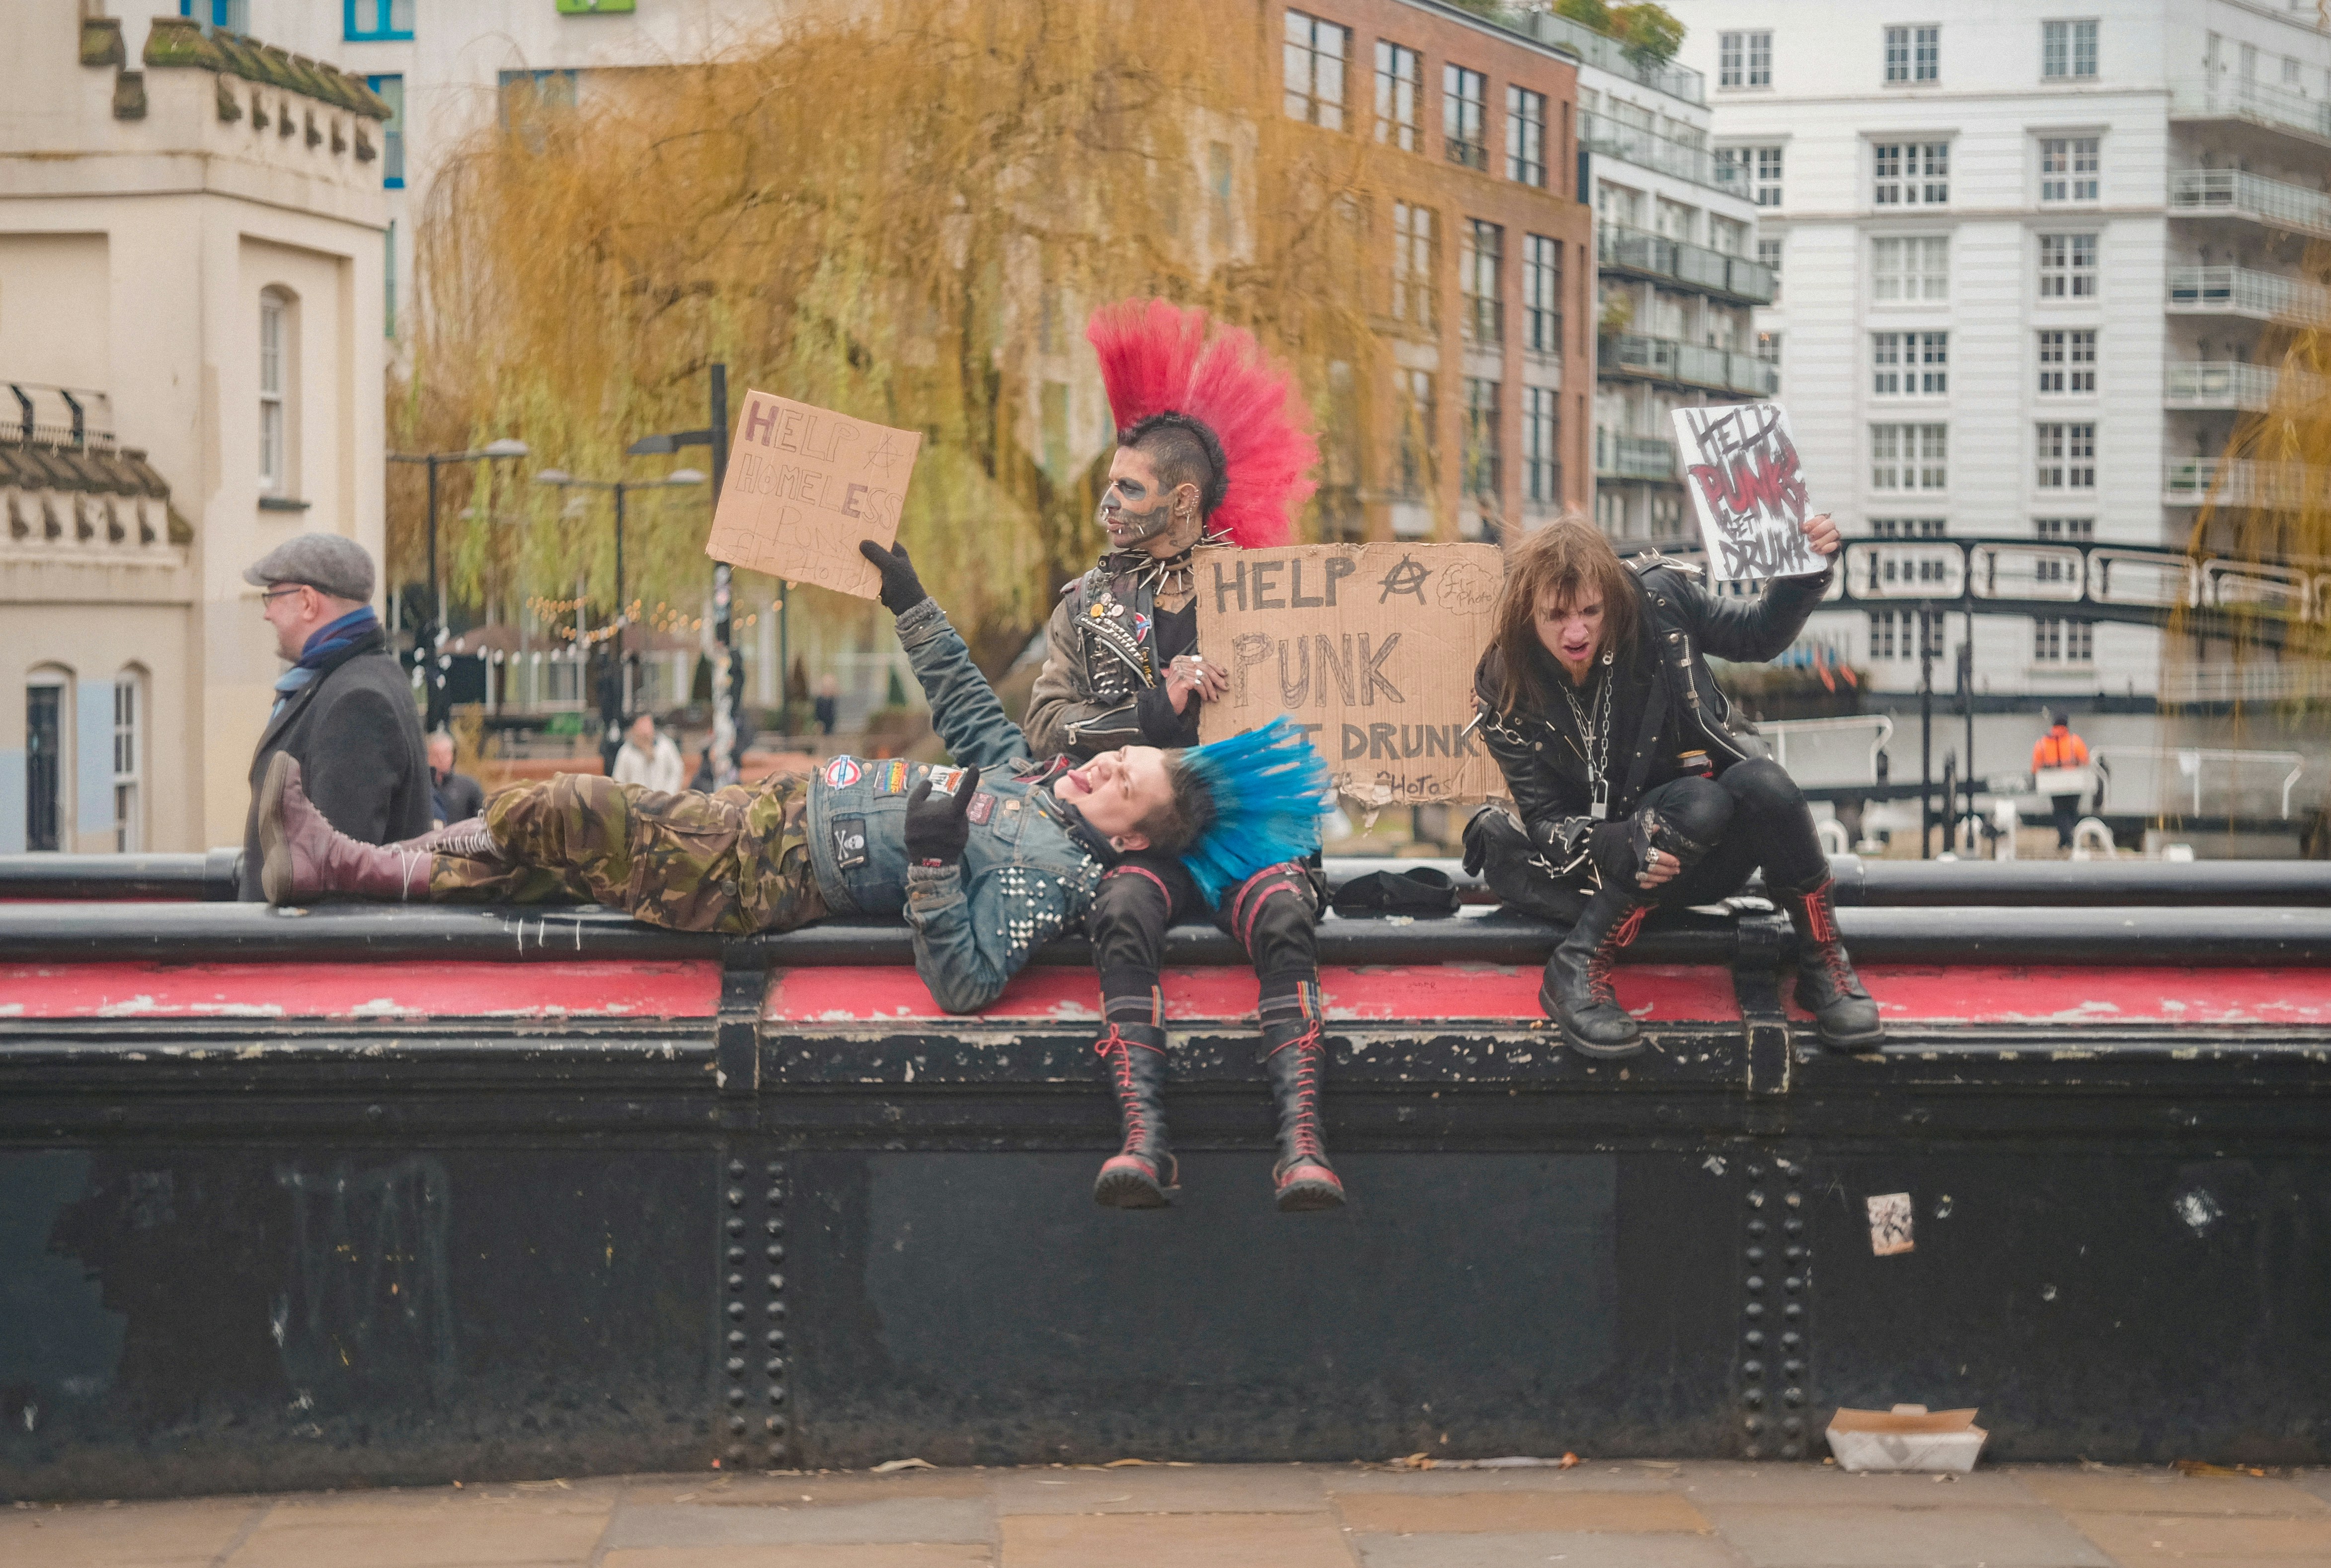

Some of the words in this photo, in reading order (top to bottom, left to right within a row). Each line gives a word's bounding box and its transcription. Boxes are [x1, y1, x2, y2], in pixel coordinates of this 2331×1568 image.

[745, 400, 860, 463] HELP
[1685, 404, 1781, 465] HELP
[735, 453, 903, 530] HOMELESS
[773, 506, 857, 557] PUNK
[1718, 520, 1810, 578] DRUNK
[1212, 557, 1356, 614] HELP
[1378, 553, 1434, 605] A
[1233, 631, 1405, 709] PUNK
[1341, 722, 1480, 760] DRUNK
